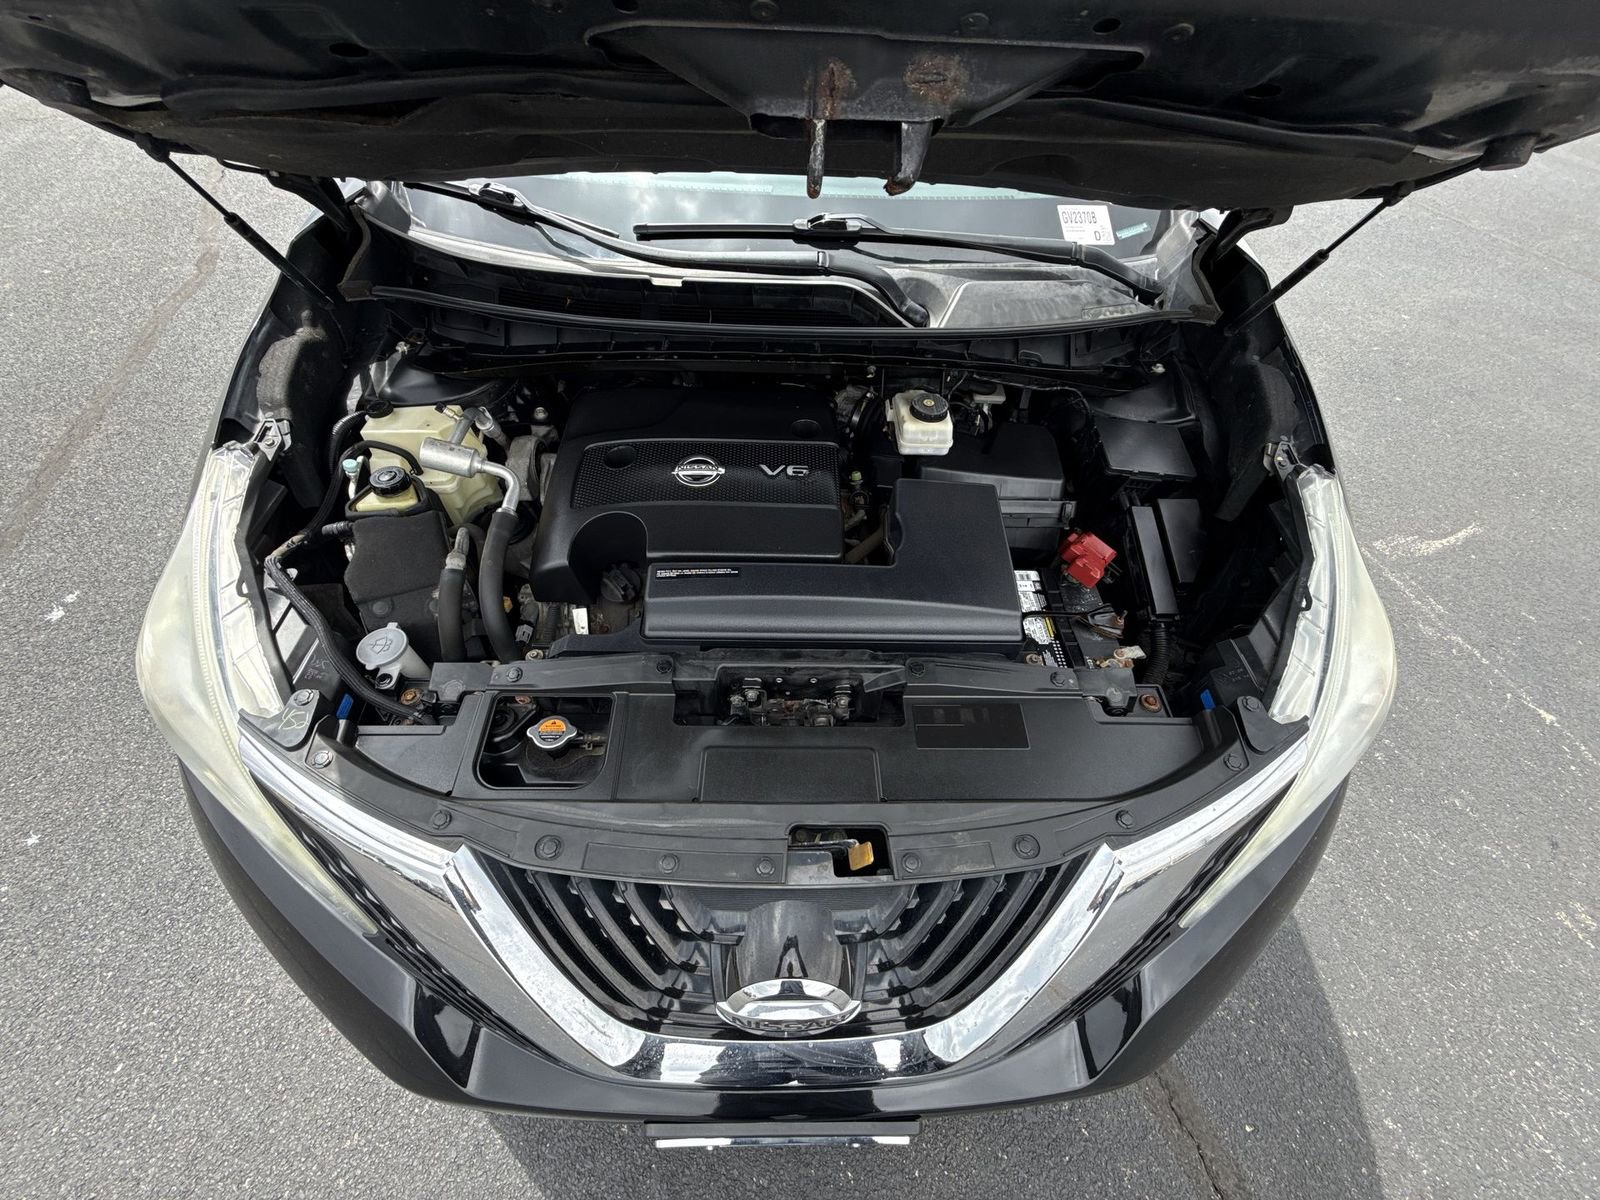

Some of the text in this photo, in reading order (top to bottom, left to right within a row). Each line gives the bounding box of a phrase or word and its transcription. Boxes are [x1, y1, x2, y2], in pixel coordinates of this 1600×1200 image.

[1061, 211, 1097, 224] GV2370B
[677, 463, 719, 471] NISSAN
[759, 464, 809, 477] V6
[731, 1014, 850, 1031] NISSAN
